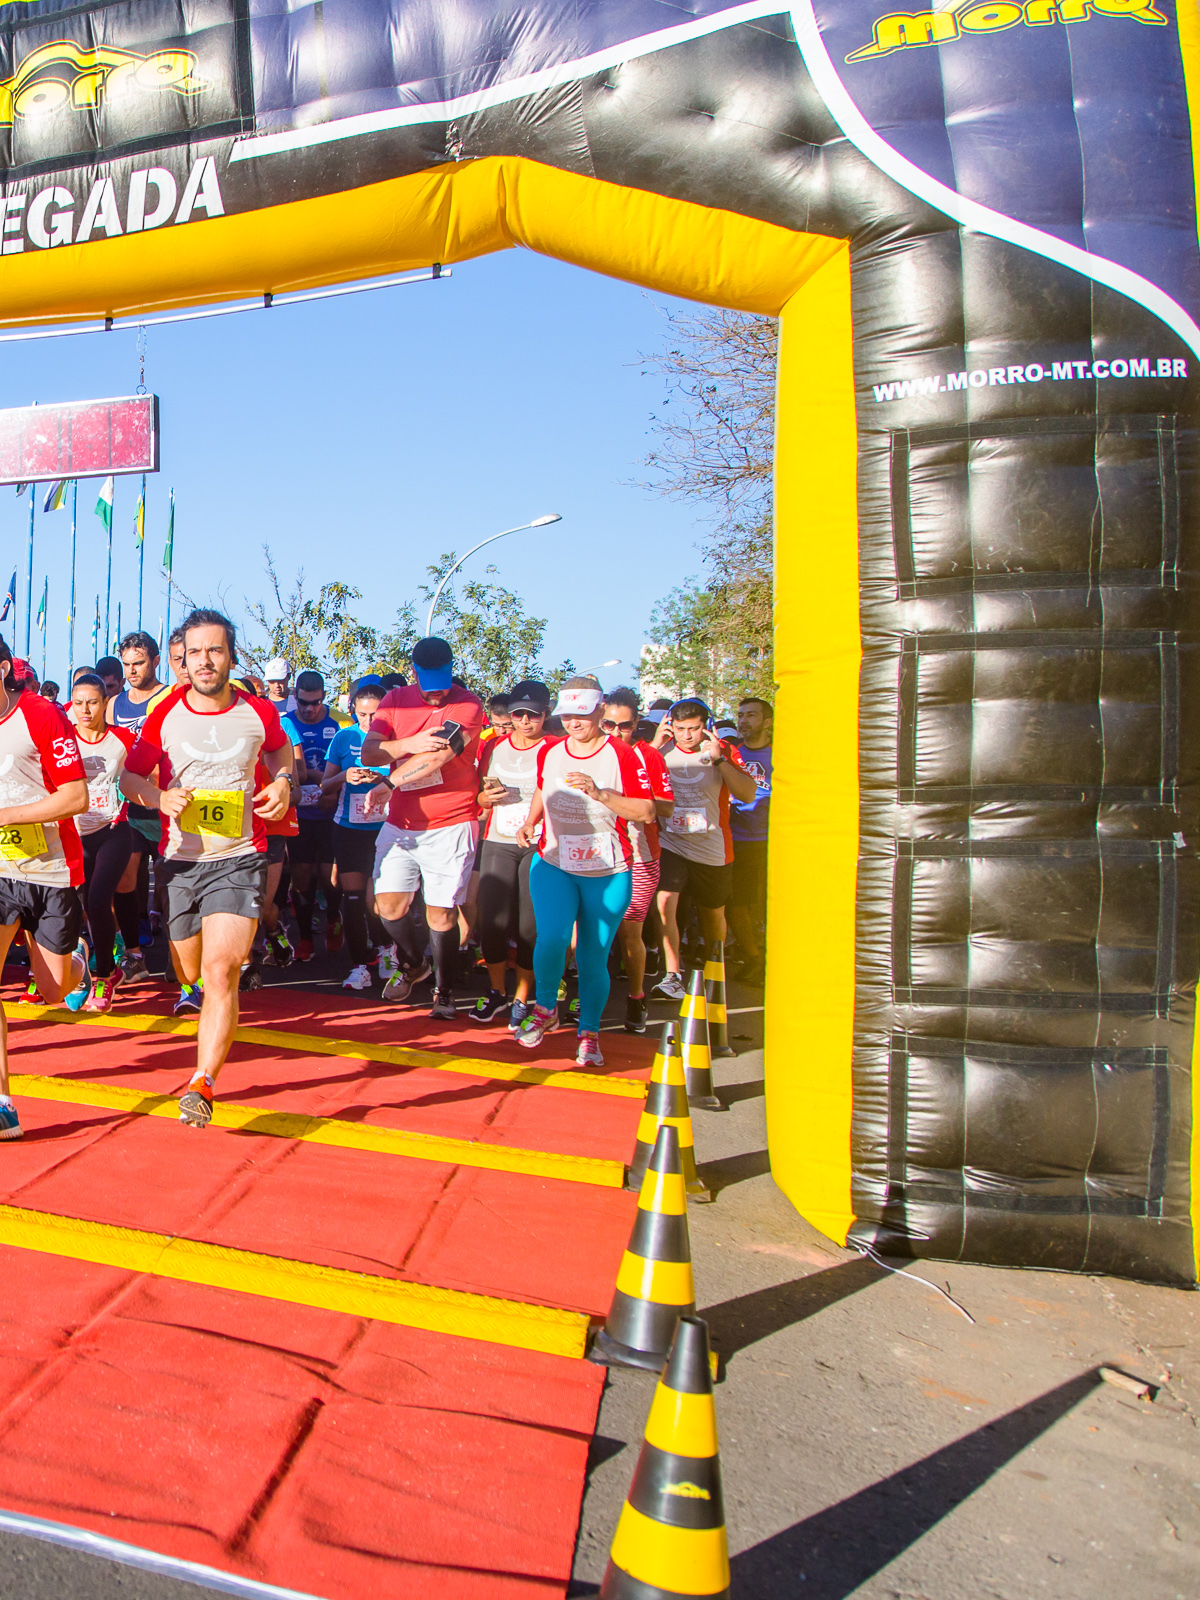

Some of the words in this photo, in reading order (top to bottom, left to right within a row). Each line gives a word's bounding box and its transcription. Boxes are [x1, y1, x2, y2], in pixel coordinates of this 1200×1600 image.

[873, 358, 1188, 403] WWW.MORRO-MT.COM.BR
[199, 805, 224, 822] 16
[673, 815, 698, 826] 518
[569, 846, 602, 860] 672
